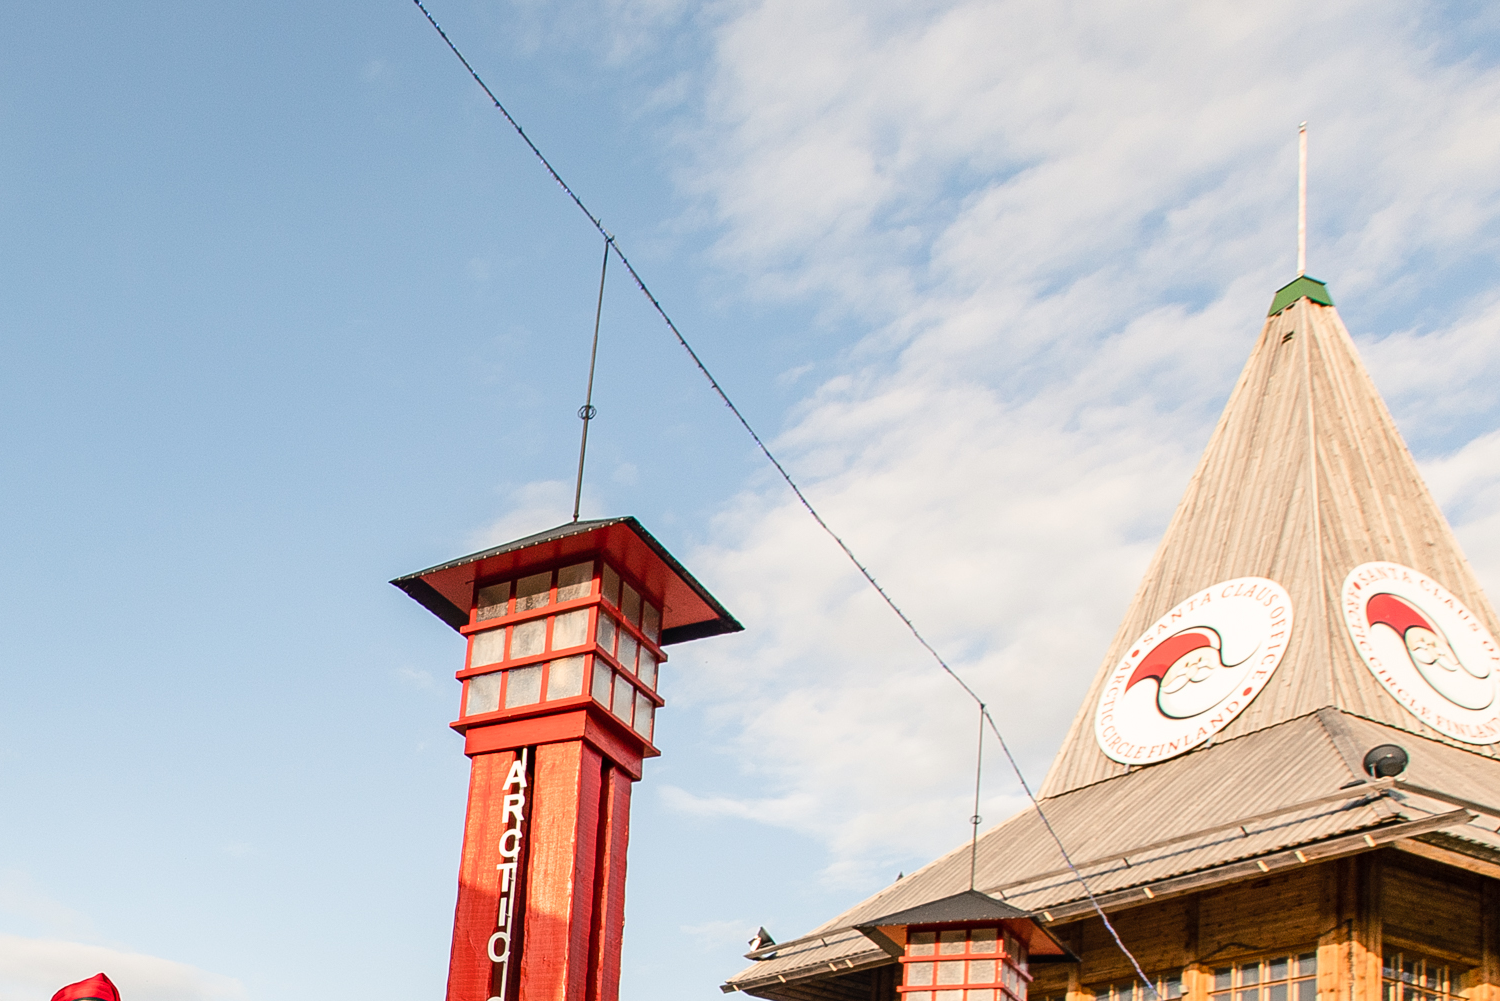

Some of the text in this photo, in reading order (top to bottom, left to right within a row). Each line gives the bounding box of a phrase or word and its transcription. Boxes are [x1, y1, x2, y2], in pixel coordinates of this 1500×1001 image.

[1143, 582, 1287, 681] SANTA CLAUS OFFICE
[1099, 660, 1241, 760] ARCTIC CIRCLE FINLAND
[486, 760, 528, 964] ARCTIC
